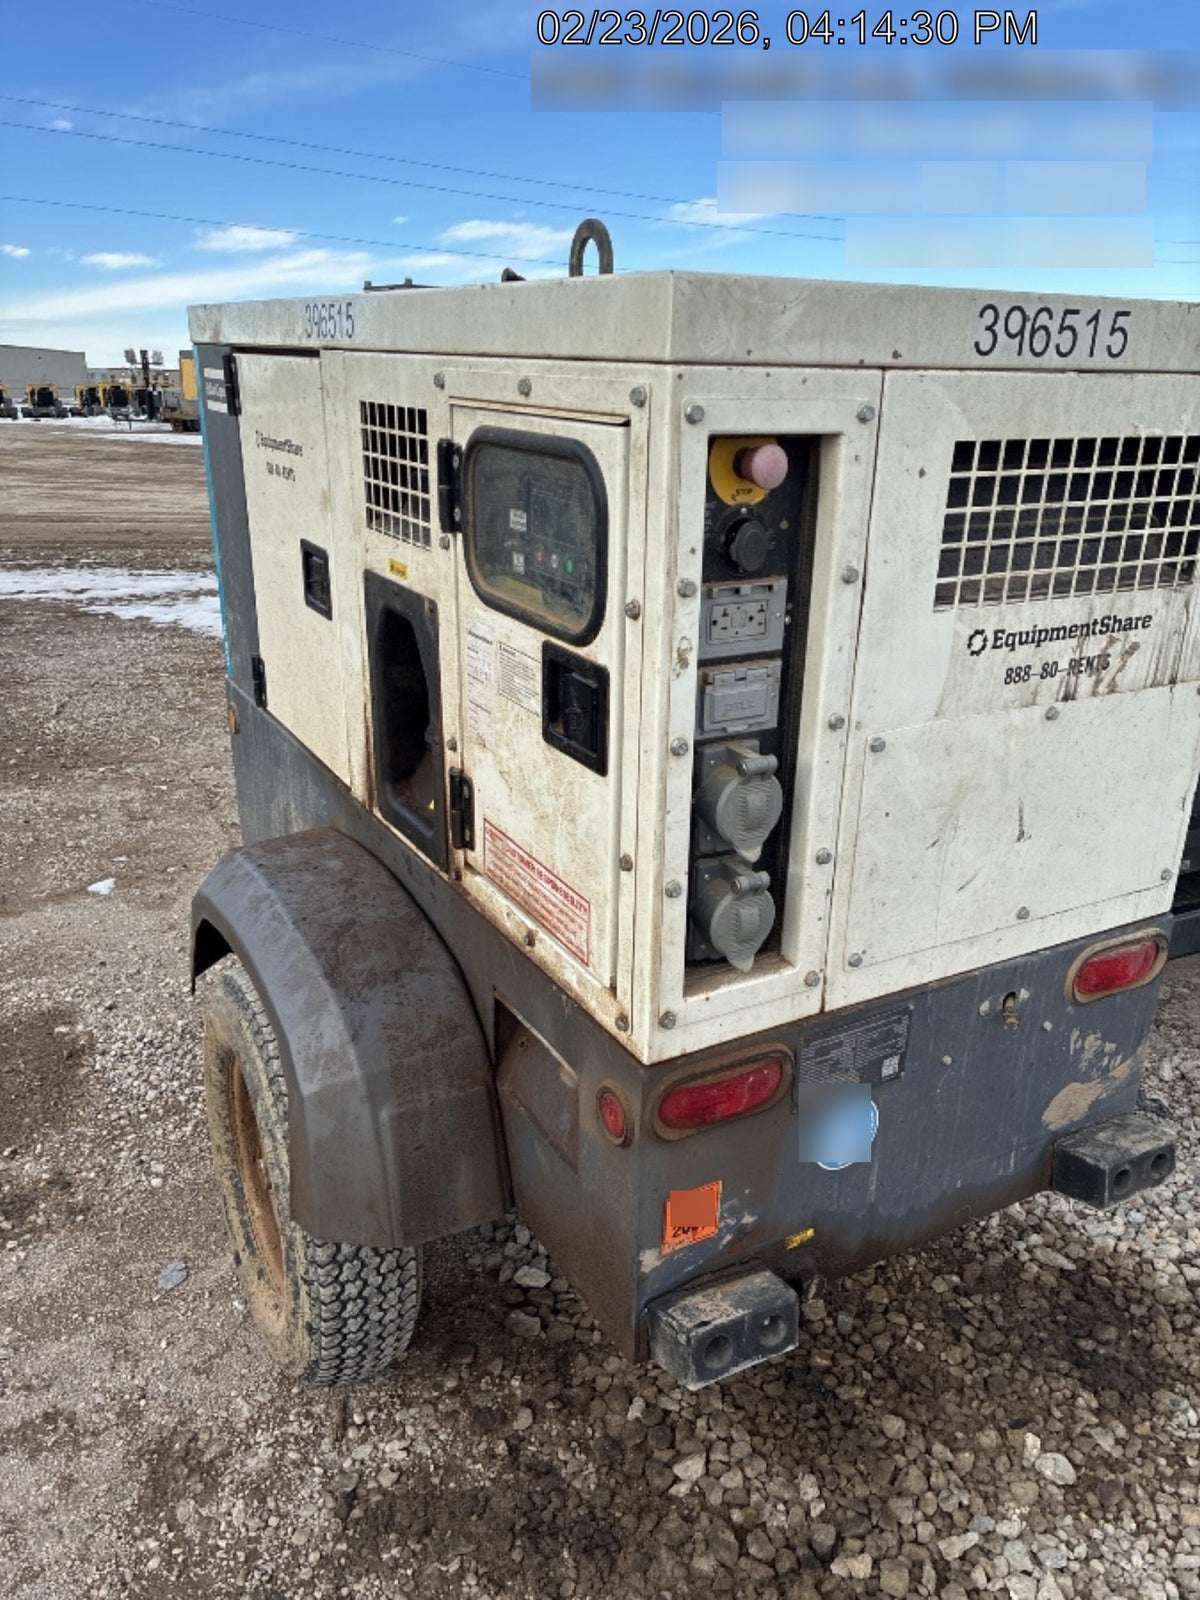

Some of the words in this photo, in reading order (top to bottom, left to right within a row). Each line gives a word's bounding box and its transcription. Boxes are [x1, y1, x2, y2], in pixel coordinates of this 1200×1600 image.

[305, 302, 355, 339] 396515
[973, 303, 1132, 359] 396515
[990, 613, 1153, 652] EquipmentShare
